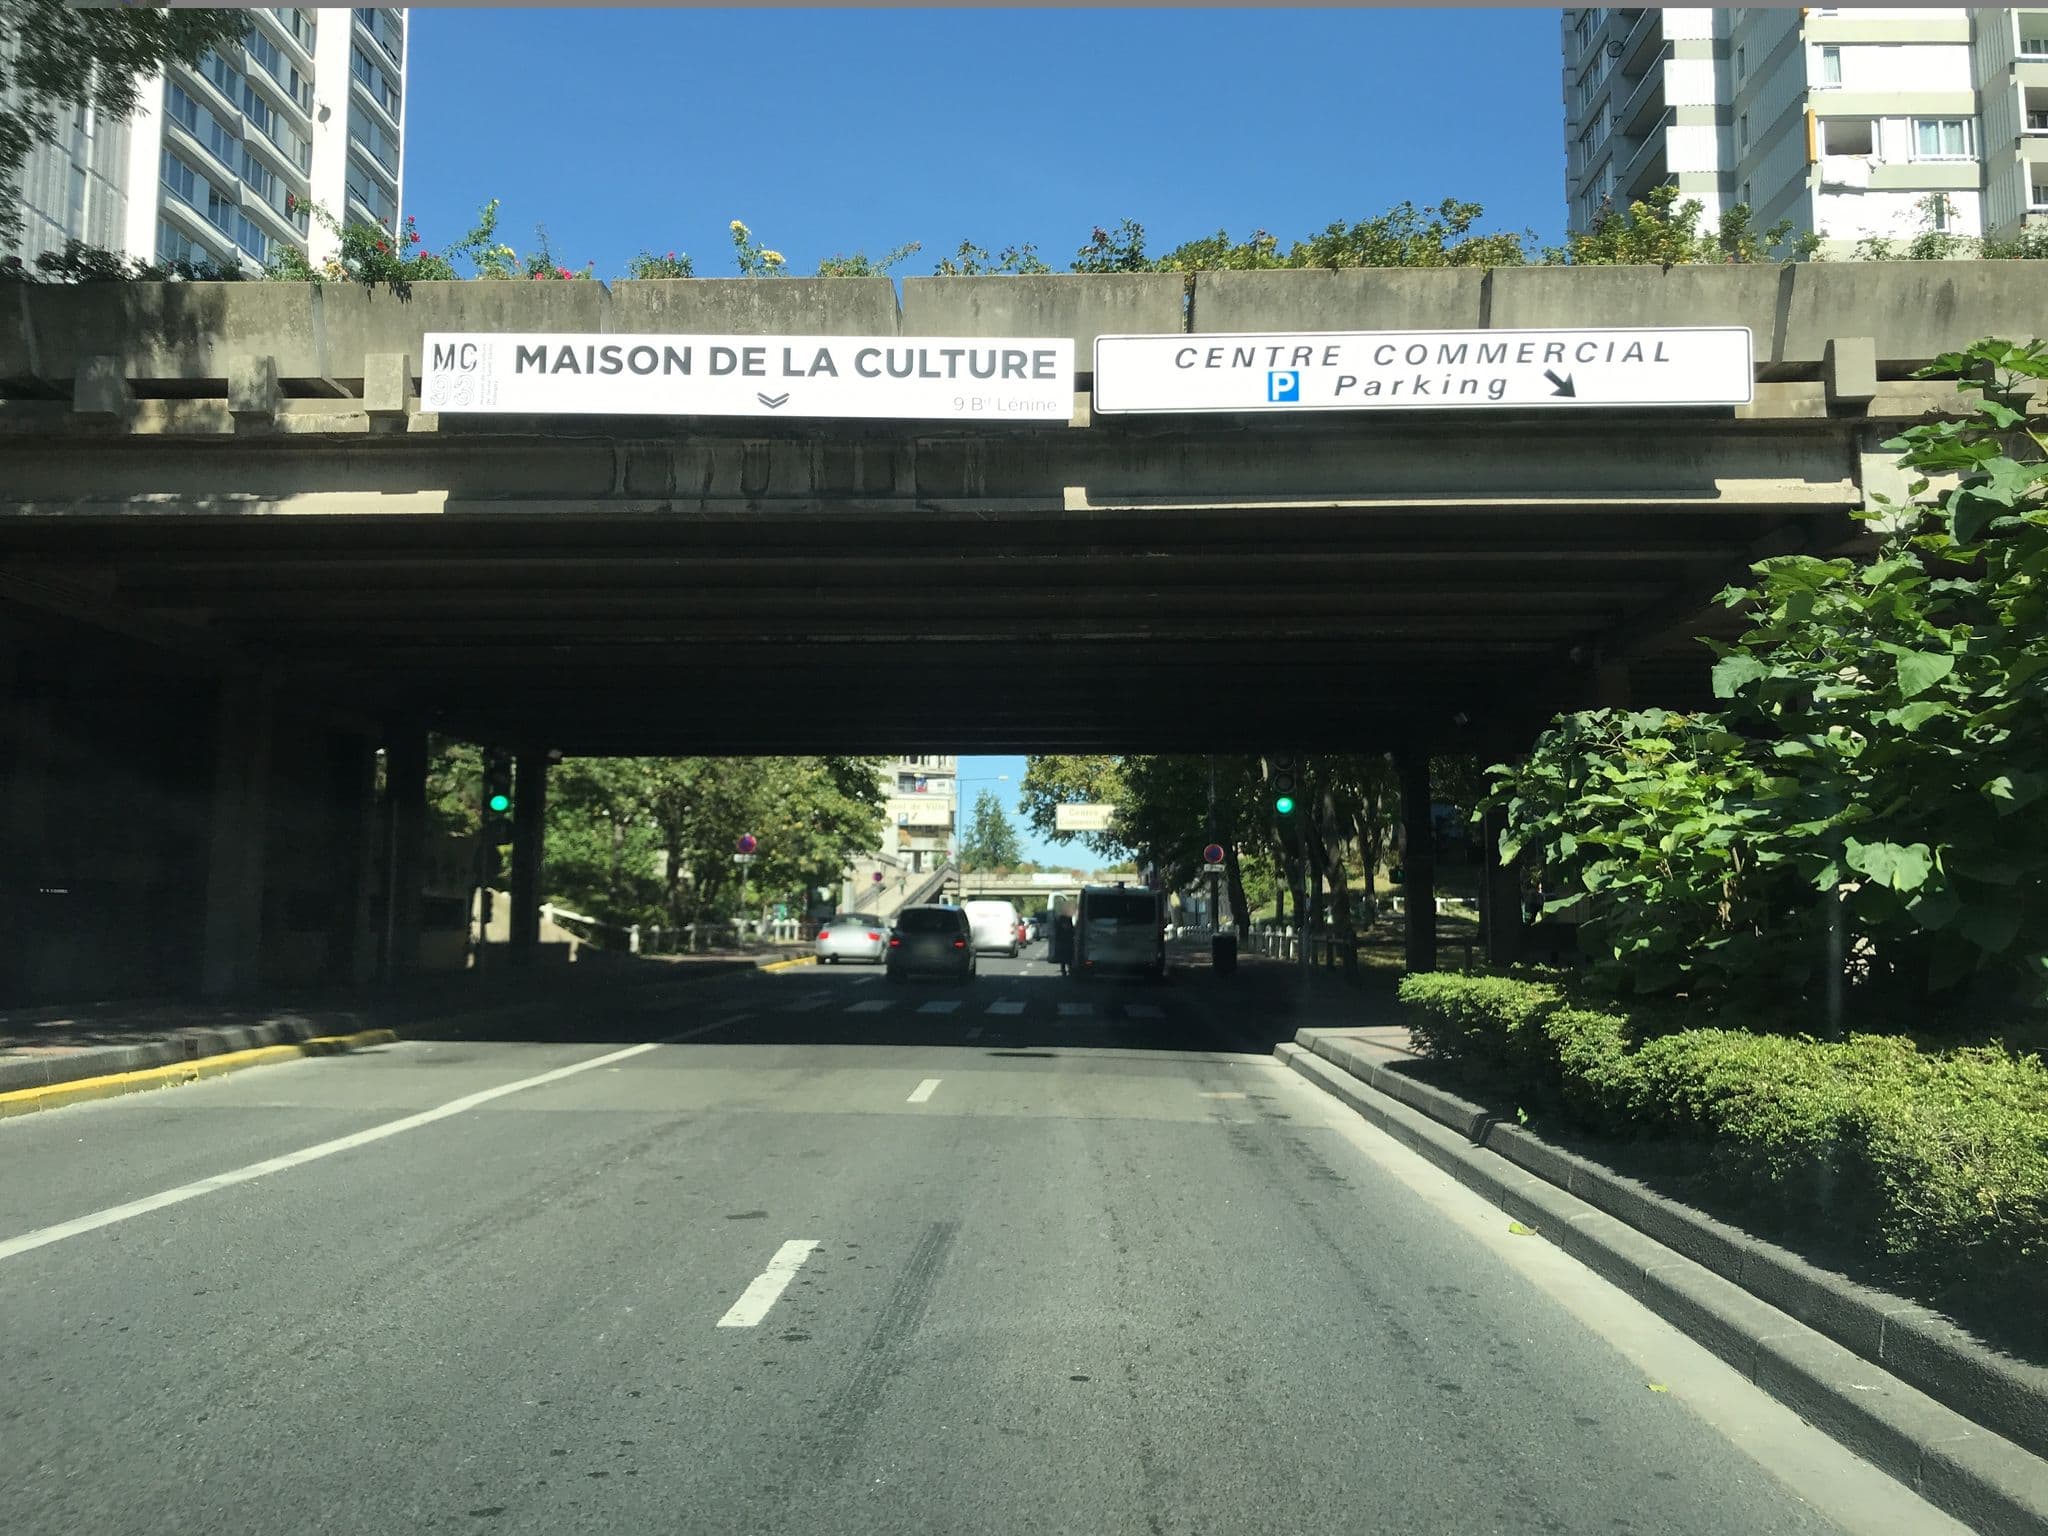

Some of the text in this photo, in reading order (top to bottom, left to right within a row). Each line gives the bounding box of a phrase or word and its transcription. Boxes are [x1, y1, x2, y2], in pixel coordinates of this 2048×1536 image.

[433, 343, 477, 371] MC
[515, 345, 692, 376] MAISON
[709, 346, 766, 376] DE
[783, 347, 839, 377] LA
[854, 348, 1057, 379] CULTURE
[1174, 340, 1671, 369] CENTRE COMMERCIAL
[431, 374, 474, 407] 93
[1272, 371, 1295, 401] P
[1334, 374, 1507, 401] Parking
[953, 397, 964, 411] 9
[997, 394, 1057, 412] Lénine
